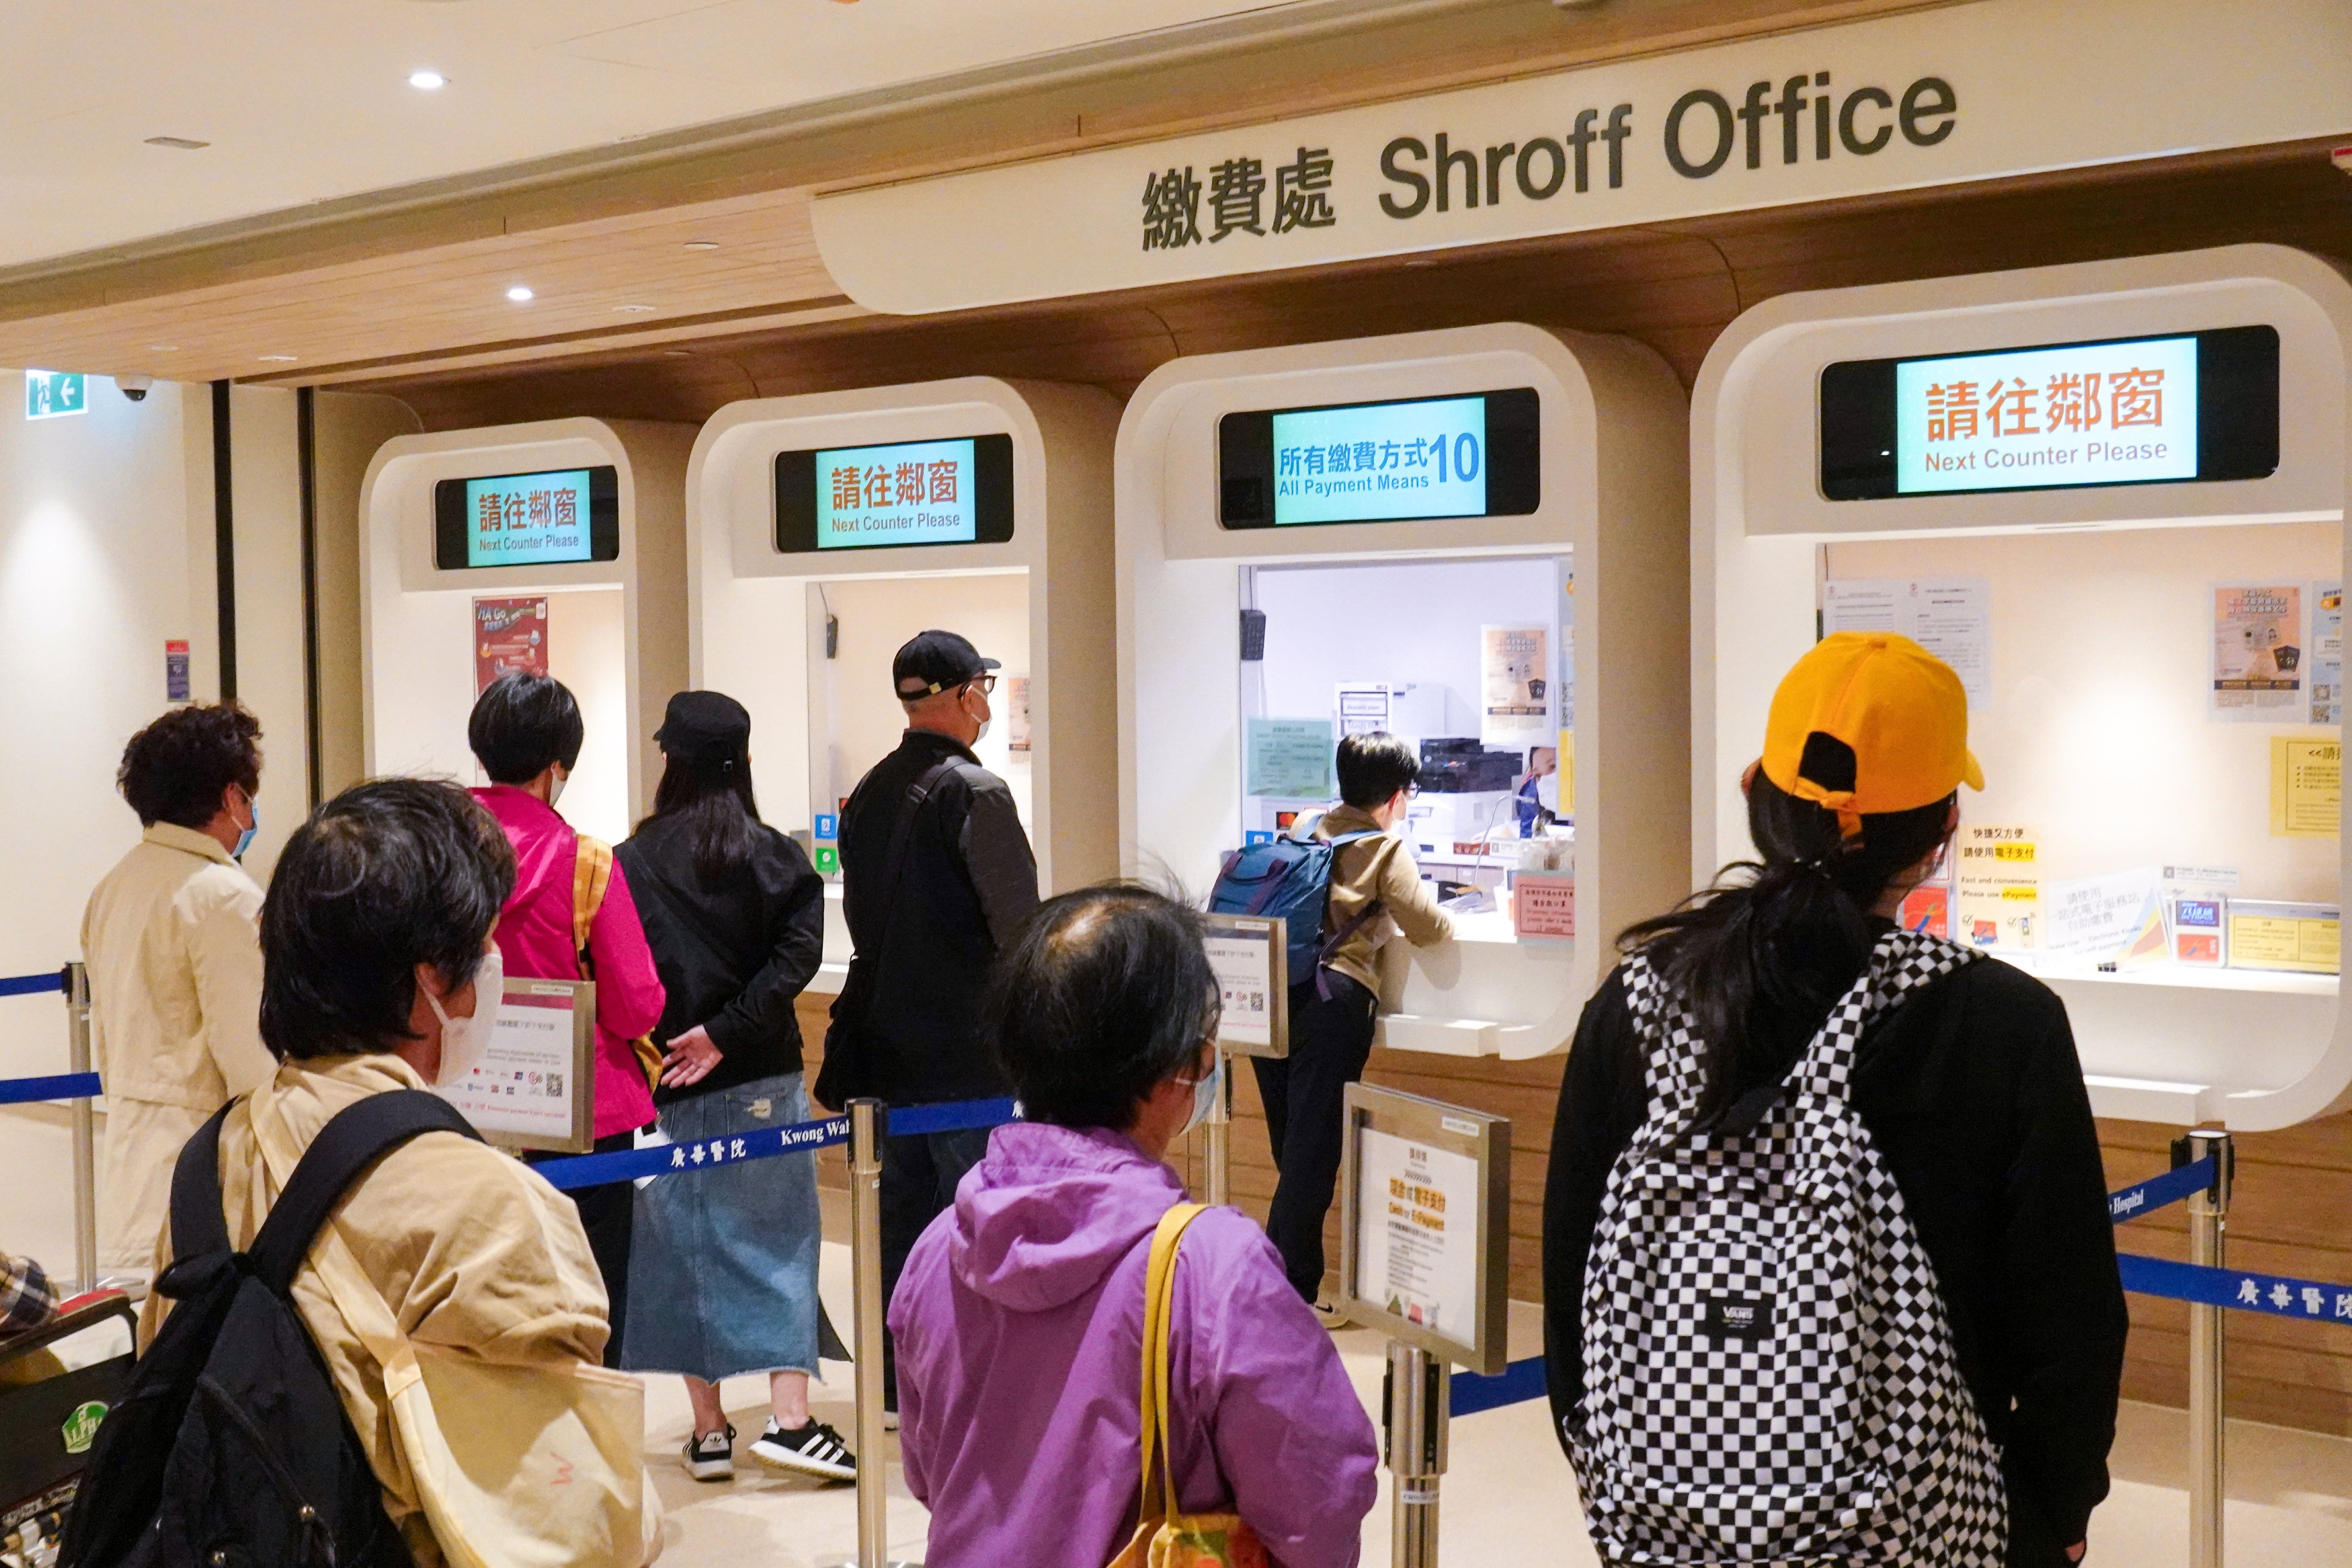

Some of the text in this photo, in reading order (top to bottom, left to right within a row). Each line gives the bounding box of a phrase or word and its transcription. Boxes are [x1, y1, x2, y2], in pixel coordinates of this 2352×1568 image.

[1142, 72, 1957, 251] 繳費處 Shroff Office
[1925, 367, 2165, 442] 請往鄰窗
[1280, 432, 1480, 483] 所有繳費方式 10
[1925, 441, 2167, 472] Next Counter Please
[832, 459, 957, 511] 請往鄰窗
[1279, 474, 1428, 497] All Payment Means
[479, 488, 577, 532] 請往鄰窗
[832, 513, 960, 532] Next Counter Please
[480, 534, 578, 551] Next Counter Please
[781, 1128, 824, 1146] Kwong
[2114, 1189, 2144, 1215] Hospital
